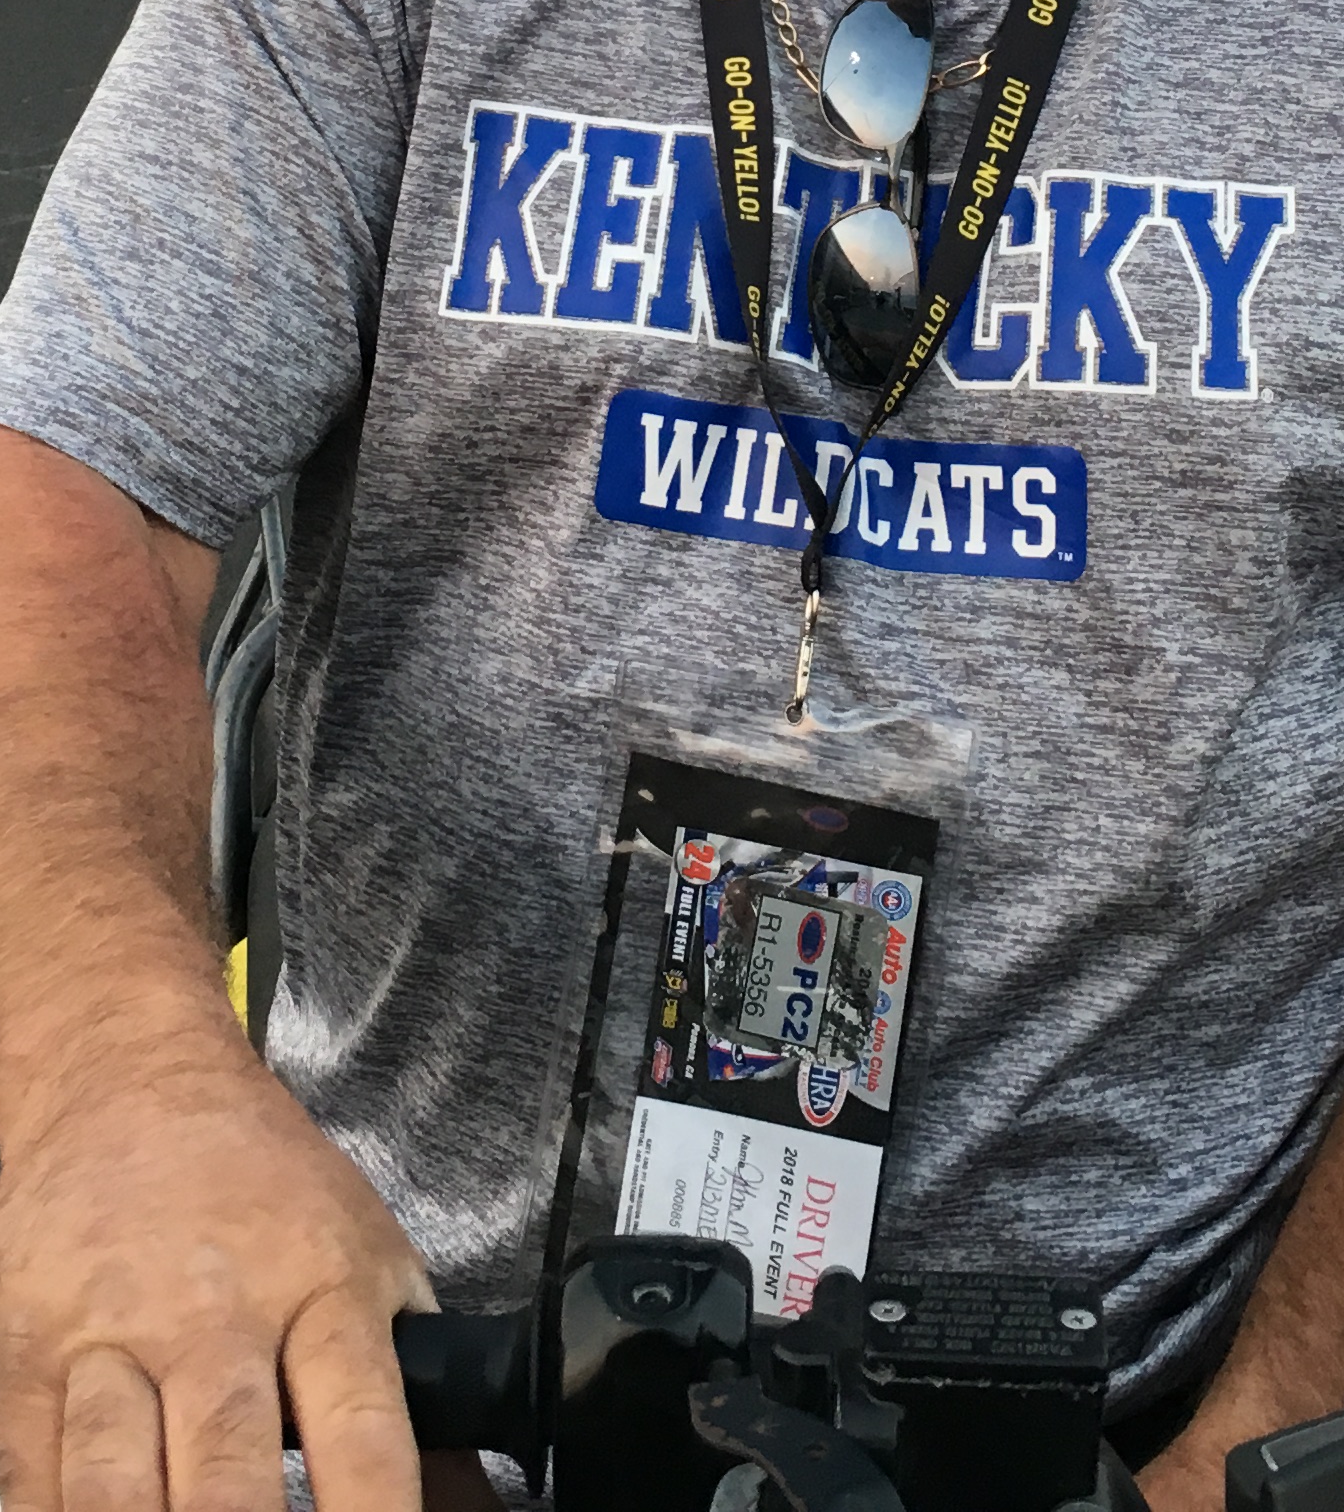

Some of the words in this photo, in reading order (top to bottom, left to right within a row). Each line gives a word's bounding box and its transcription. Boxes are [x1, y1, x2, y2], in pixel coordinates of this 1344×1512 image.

[724, 57, 762, 222] GO-ON-YELLO!
[958, 77, 1031, 240] GO-ON-YELLO!
[639, 411, 1057, 559] WILDCATS
[1057, 551, 1074, 562] TM
[682, 842, 716, 882] 24
[681, 884, 695, 915] FULL
[671, 917, 690, 963] EVENT
[882, 926, 907, 985] Auto
[744, 911, 783, 1017] R1-5356
[780, 966, 820, 1042] PC2
[872, 1017, 890, 1052] Auto
[685, 1064, 695, 1079] CA
[867, 1053, 884, 1093] Club
[706, 1129, 724, 1163] Entry
[738, 1134, 751, 1169] Name
[779, 1146, 798, 1187] 2018
[669, 1178, 687, 1229] 000885
[772, 1190, 792, 1235] FULL
[779, 1174, 837, 1320] DRIVER
[763, 1240, 784, 1300] EVENT
